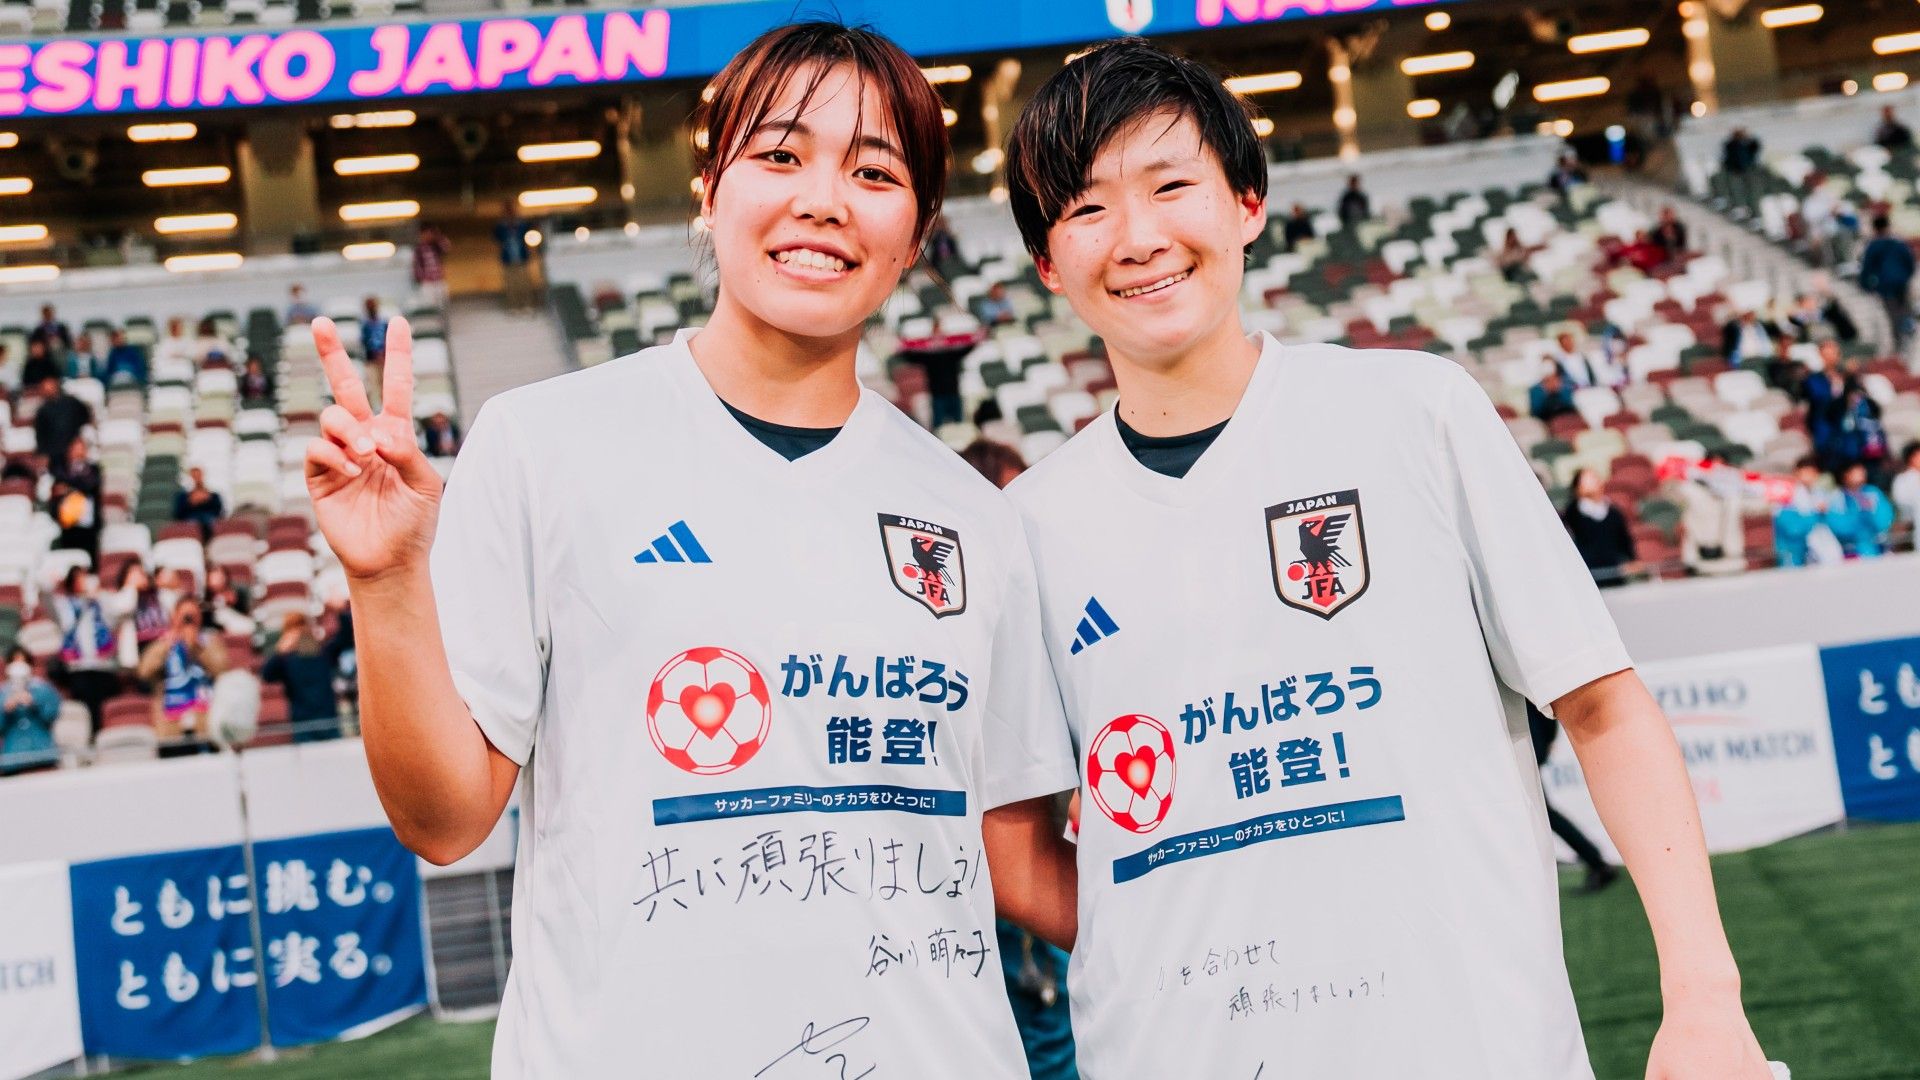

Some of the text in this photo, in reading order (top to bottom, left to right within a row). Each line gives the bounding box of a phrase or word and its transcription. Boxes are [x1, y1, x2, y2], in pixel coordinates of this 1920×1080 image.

[348, 9, 670, 97] JAPAN
[899, 517, 943, 534] JAPAN
[1286, 495, 1337, 514] JAPAN
[917, 581, 951, 605] JFA
[1302, 577, 1346, 600] JFA
[781, 654, 969, 711] がんばろう
[1179, 666, 1382, 745] がんばろう
[826, 716, 938, 766] 能登!
[1228, 732, 1350, 800] 能登!
[714, 792, 936, 812] サッカーファミリーのチカラをひとつに!
[1147, 810, 1346, 865] サッカーファミリーのチカラをひとつに!
[111, 858, 394, 936] ともに挑む。
[116, 931, 392, 1010] ともに実る。
